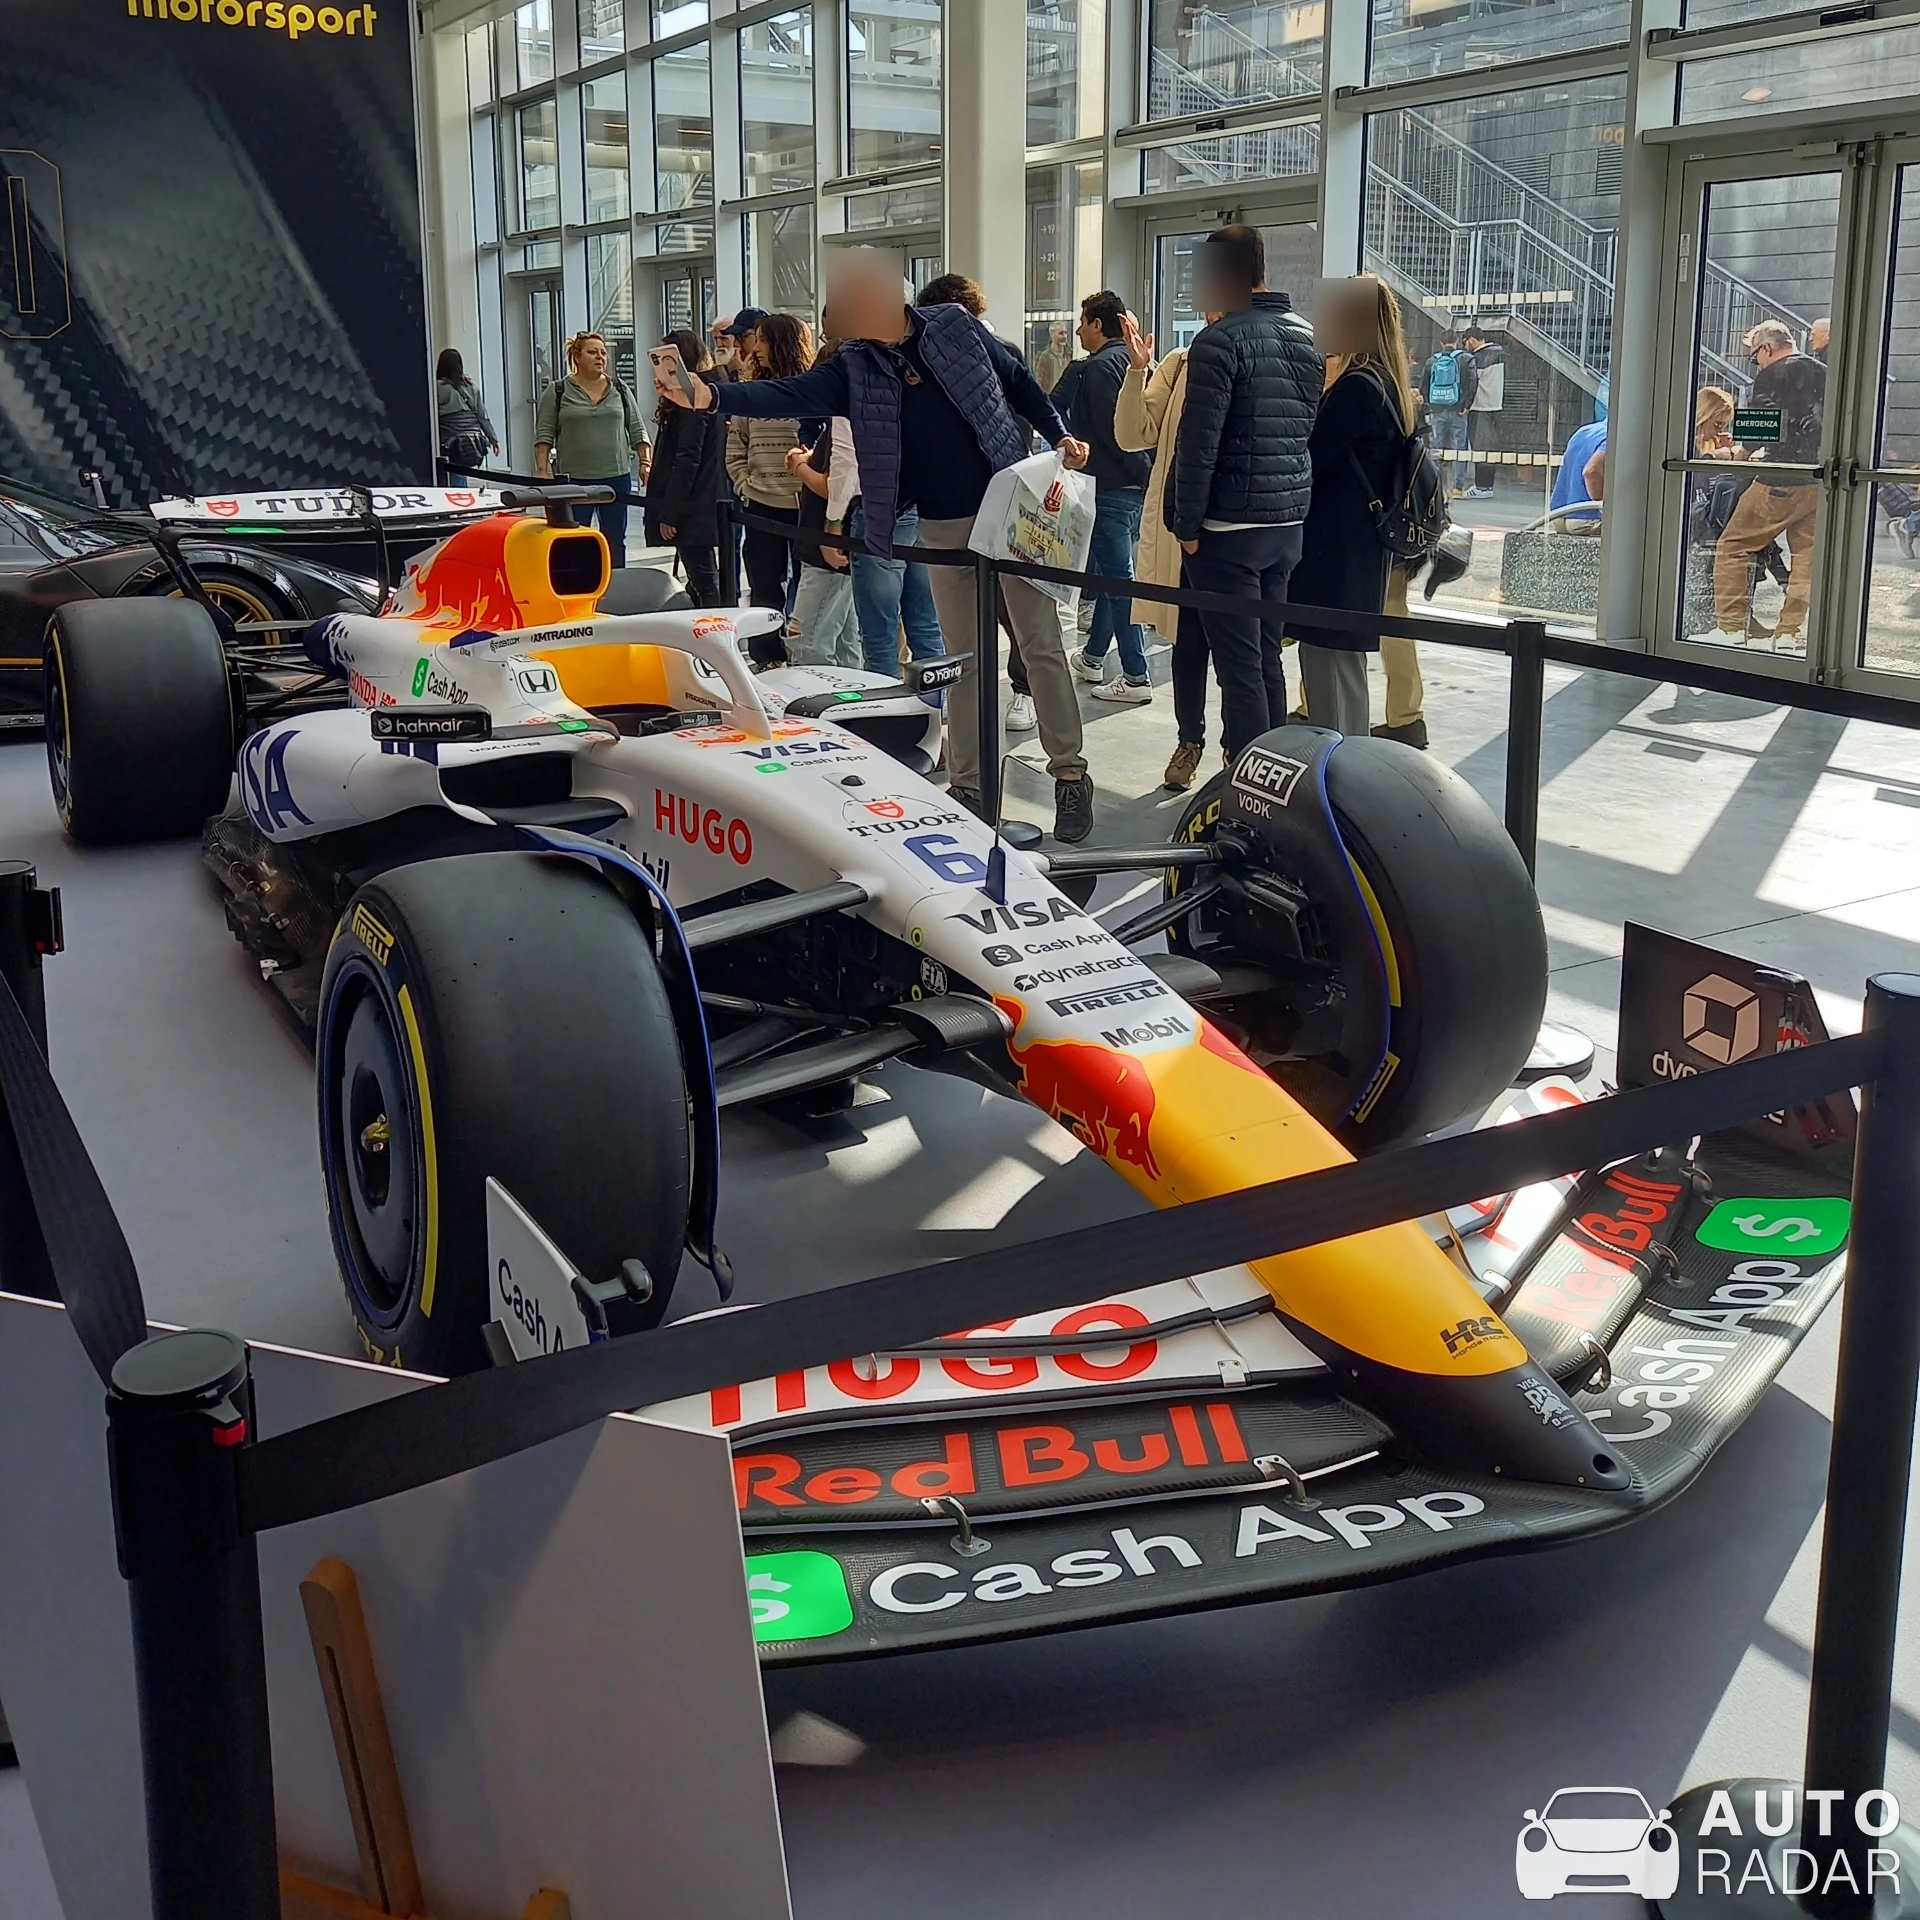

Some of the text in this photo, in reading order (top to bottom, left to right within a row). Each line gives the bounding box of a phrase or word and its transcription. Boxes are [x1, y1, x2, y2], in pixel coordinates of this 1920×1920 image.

[126, 0, 377, 39] motorsport
[1735, 420, 1779, 428] EMERGENZA
[427, 671, 448, 700] Cash
[396, 718, 463, 734] hahnair
[730, 740, 851, 760] VISA
[790, 756, 832, 768] Cash
[835, 754, 868, 764] App
[1239, 755, 1295, 792] NEFT
[655, 788, 753, 866] HUGO
[847, 812, 969, 839] TUDOR
[903, 833, 988, 884] 6
[944, 896, 1089, 935] VISA
[351, 903, 395, 967] PIRELLI
[1024, 937, 1073, 955] Cash
[1076, 931, 1114, 948] App
[1038, 954, 1142, 985] dynatrace
[1045, 979, 1169, 1018] PIRELLI
[1100, 1015, 1191, 1049] Mobil
[1576, 1169, 1683, 1256] Bull
[1521, 1225, 1638, 1330] Red
[498, 1257, 548, 1354] Cash
[1440, 1316, 1505, 1354] HRC
[1585, 1257, 1815, 1443] Cash App
[1515, 1377, 1542, 1391] VISA
[733, 1403, 1249, 1509] Red Bull
[869, 1491, 1485, 1614] Cash App
